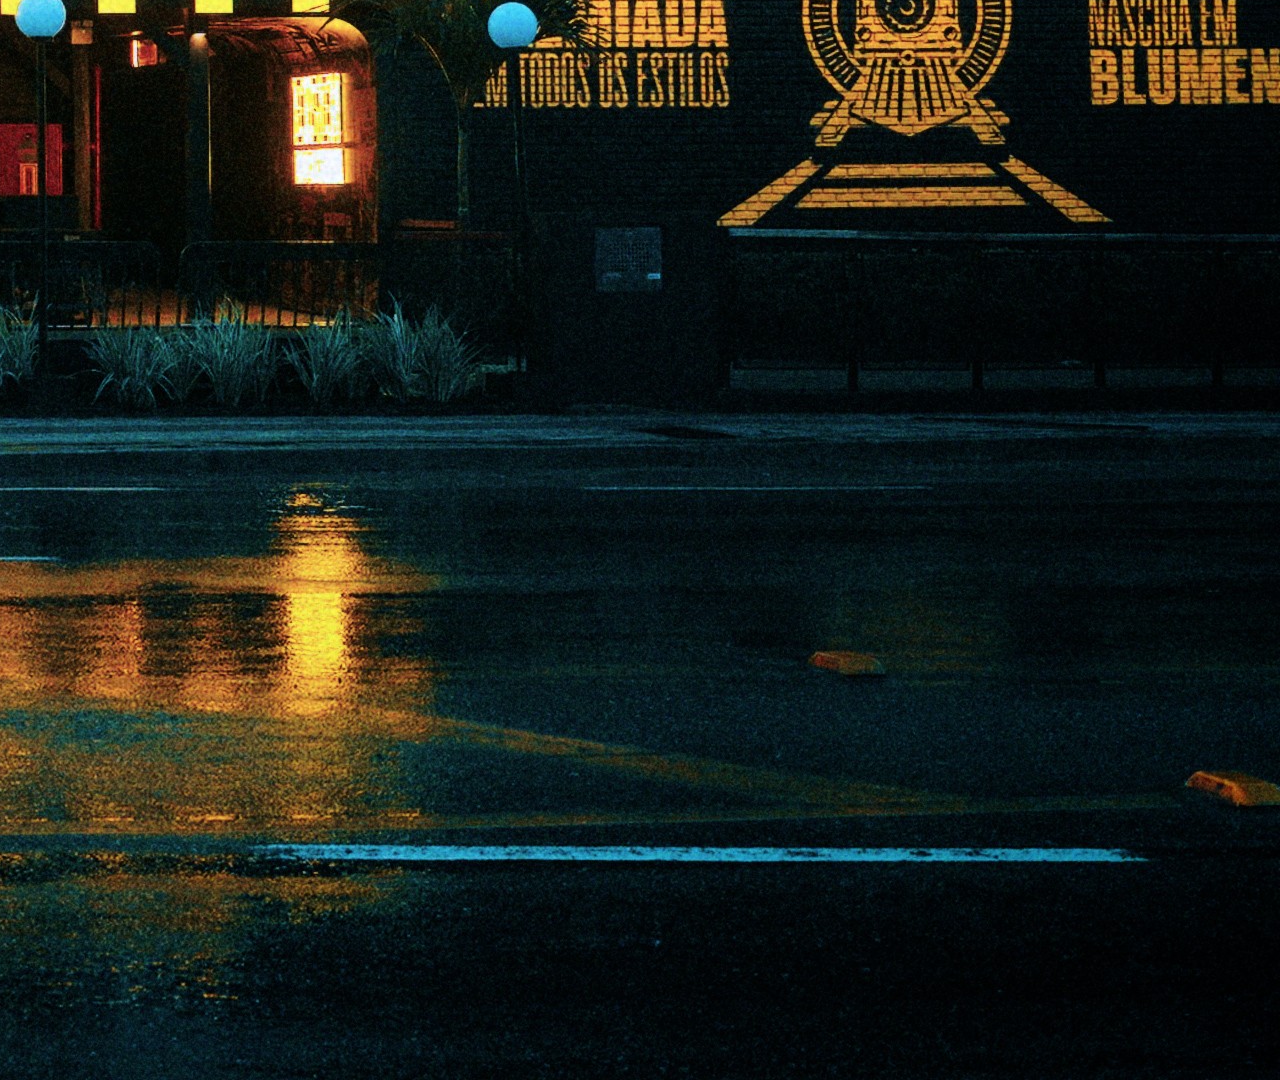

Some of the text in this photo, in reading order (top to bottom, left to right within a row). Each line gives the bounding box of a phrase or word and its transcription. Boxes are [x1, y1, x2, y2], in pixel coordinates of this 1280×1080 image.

[473, 52, 730, 108] M TODOS OS ESTILOS
